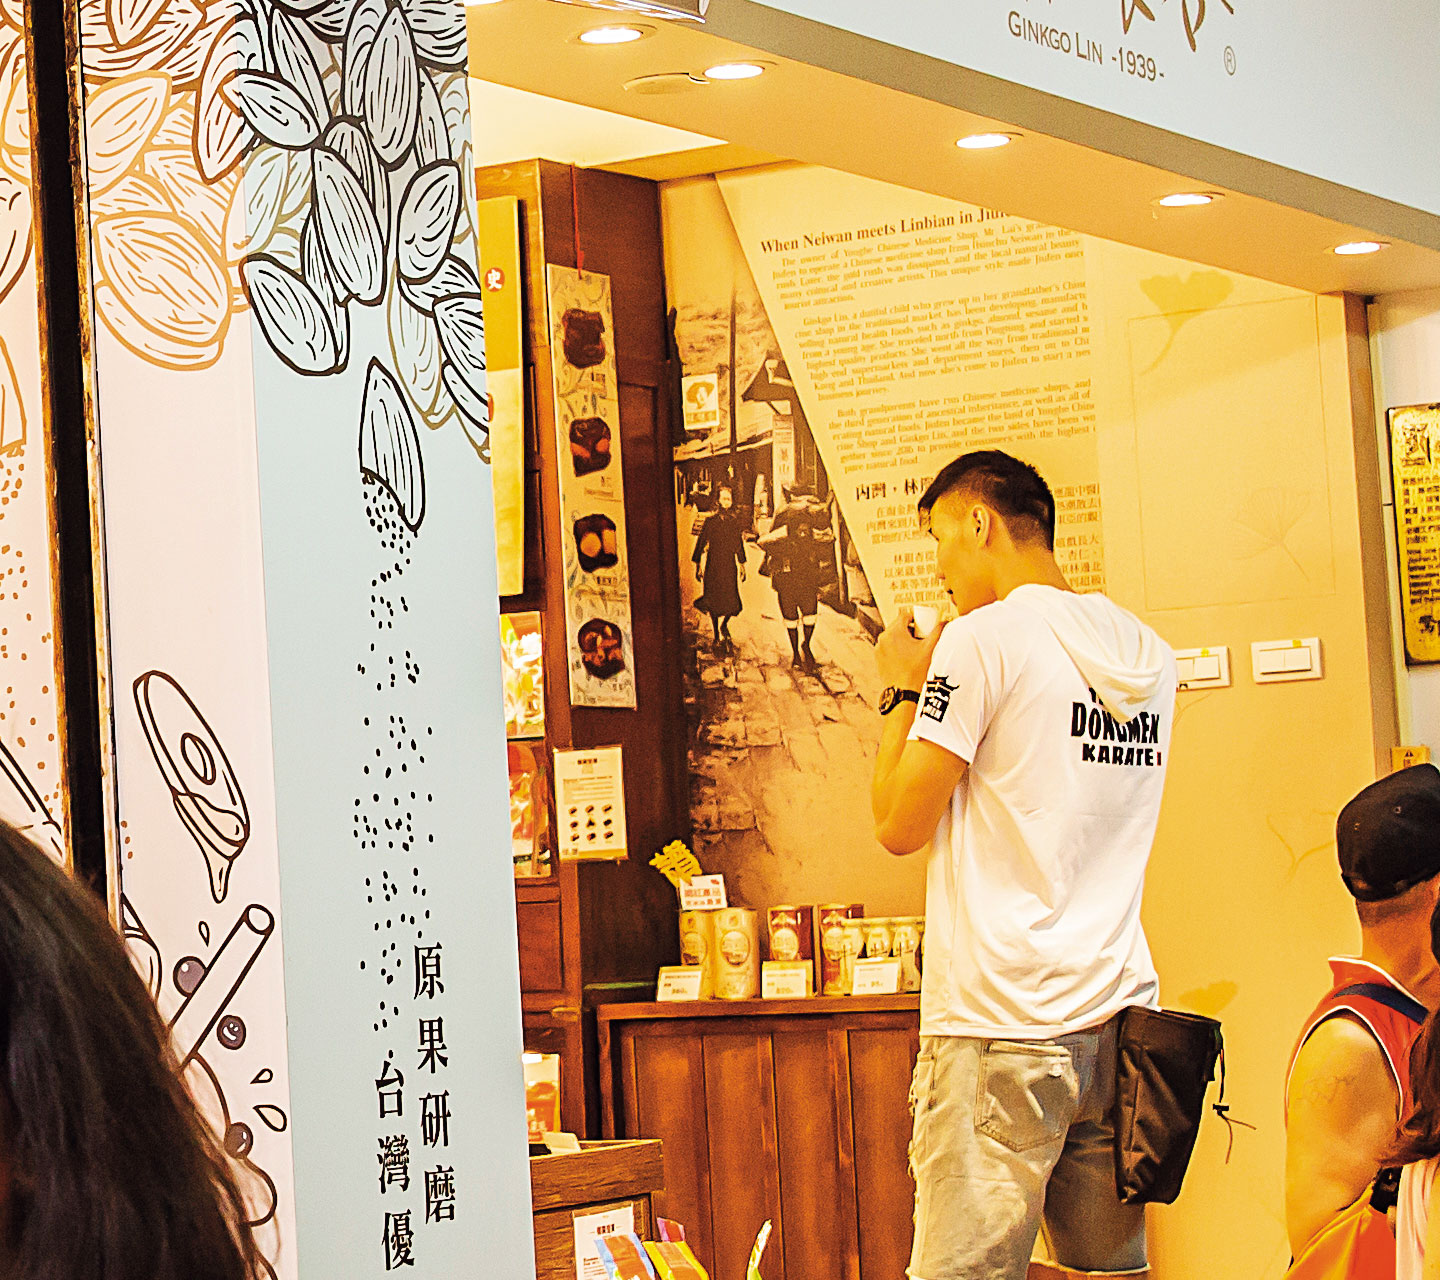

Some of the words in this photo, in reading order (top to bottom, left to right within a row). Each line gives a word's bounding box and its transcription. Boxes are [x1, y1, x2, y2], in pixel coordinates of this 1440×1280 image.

[1007, 10, 1072, 54] GINKGO
[1075, 29, 1103, 65] LIN
[760, 234, 799, 253] When
[803, 226, 852, 247] Neiwan
[856, 220, 896, 239] meets
[900, 211, 955, 232] Linbian
[959, 209, 973, 224] in
[1082, 743, 1154, 767] KARATE
[412, 942, 457, 1224] 原果研磨
